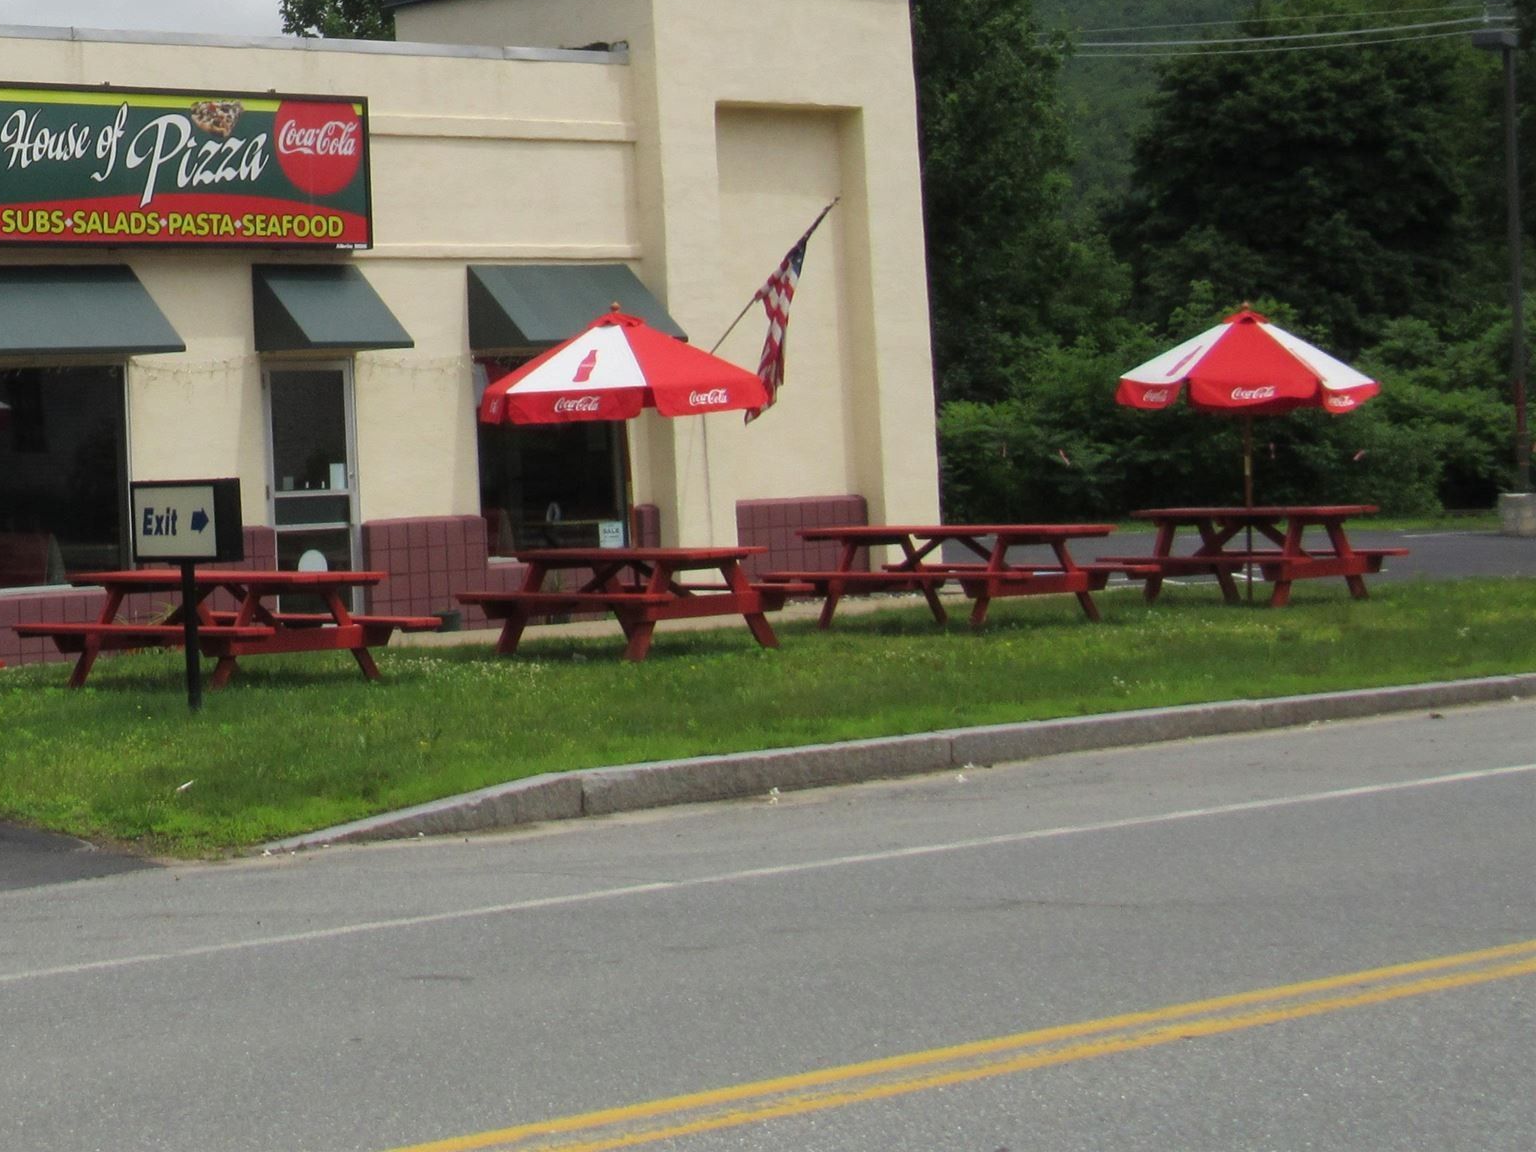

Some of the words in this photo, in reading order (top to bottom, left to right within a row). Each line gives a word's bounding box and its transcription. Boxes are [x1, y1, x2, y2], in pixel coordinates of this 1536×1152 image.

[0, 107, 92, 170] House
[90, 101, 129, 182] of
[125, 113, 271, 209] Pizza
[1, 209, 65, 233] SUBS
[72, 210, 161, 236] SALADS
[168, 214, 235, 236] PASTA
[242, 216, 344, 238] SEAFOOD
[142, 507, 178, 536] Exit
